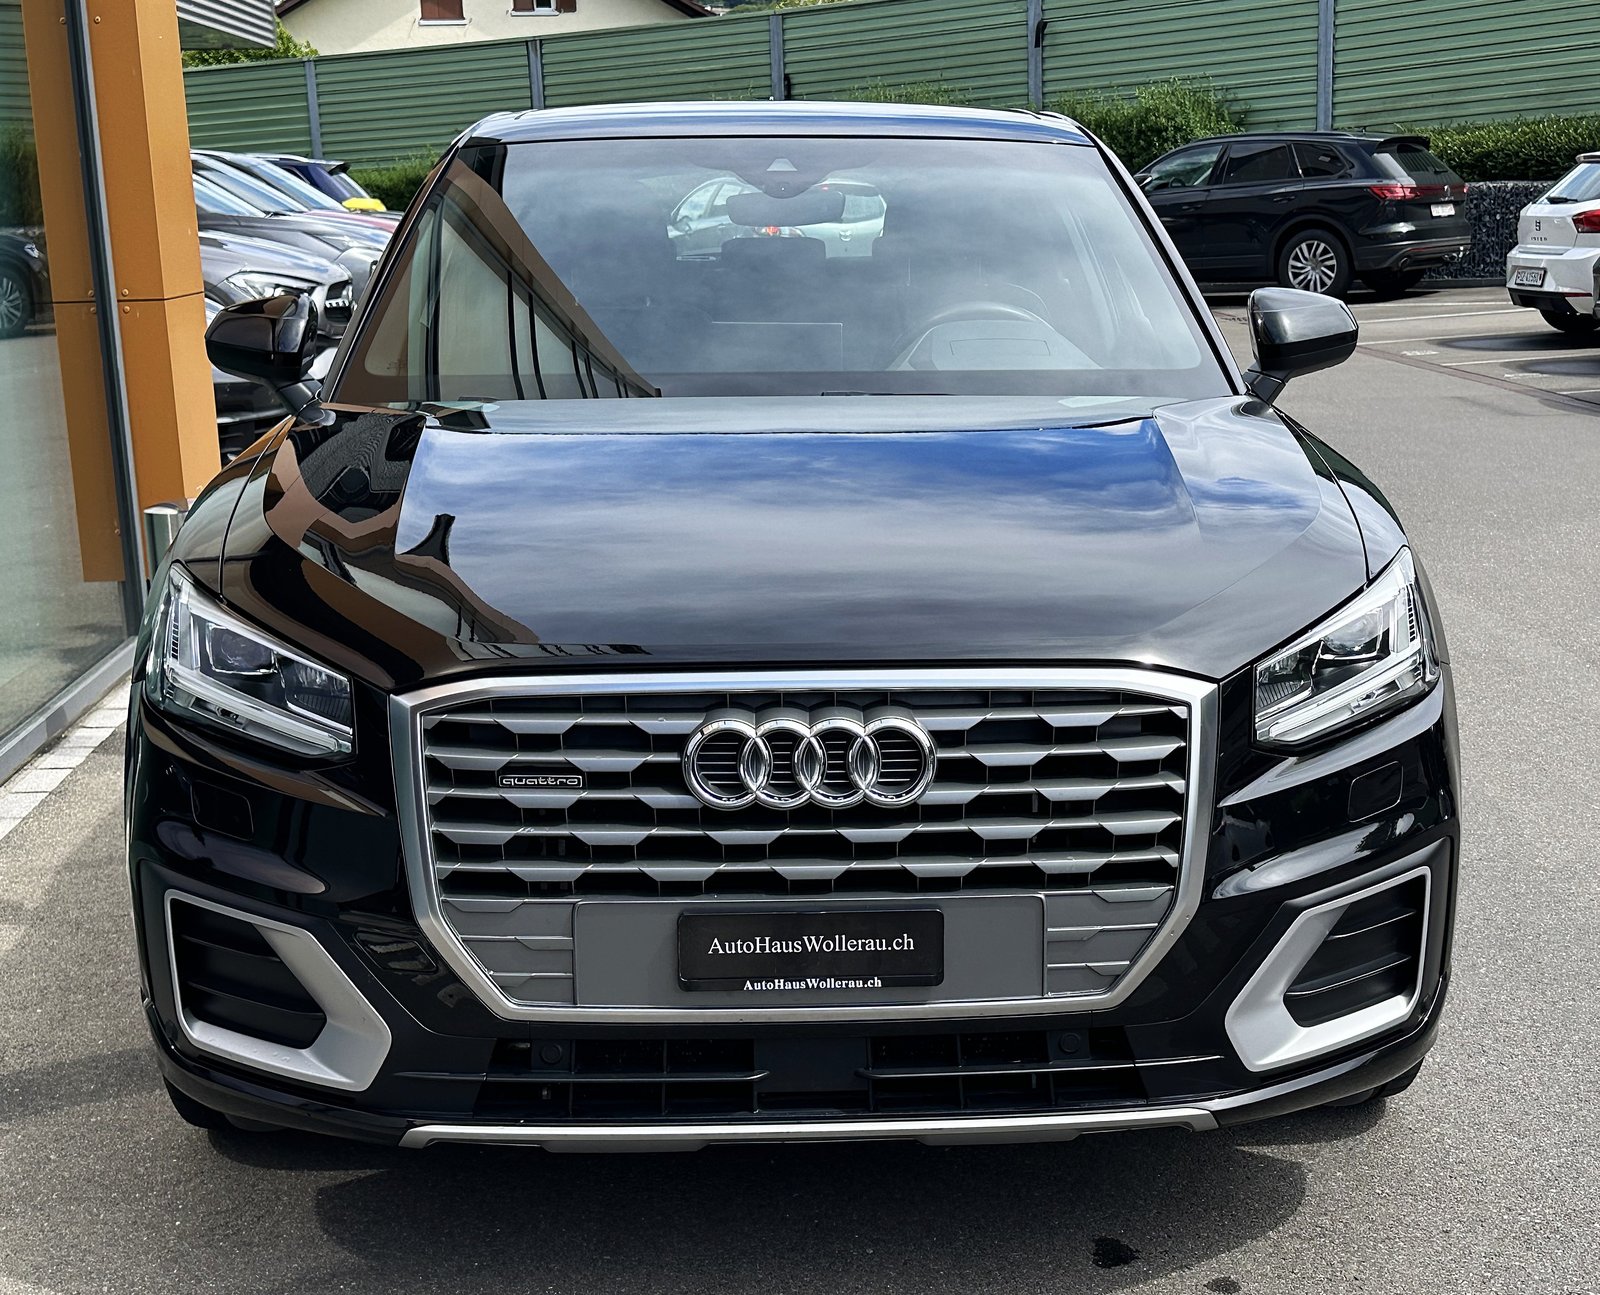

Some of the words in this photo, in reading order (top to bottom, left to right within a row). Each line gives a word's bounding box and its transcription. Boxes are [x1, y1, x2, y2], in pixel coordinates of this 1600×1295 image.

[502, 776, 579, 786] quattro
[708, 933, 915, 954] AutoHausWollerau.ch
[743, 976, 882, 991] AutoHausWollerau.ch
